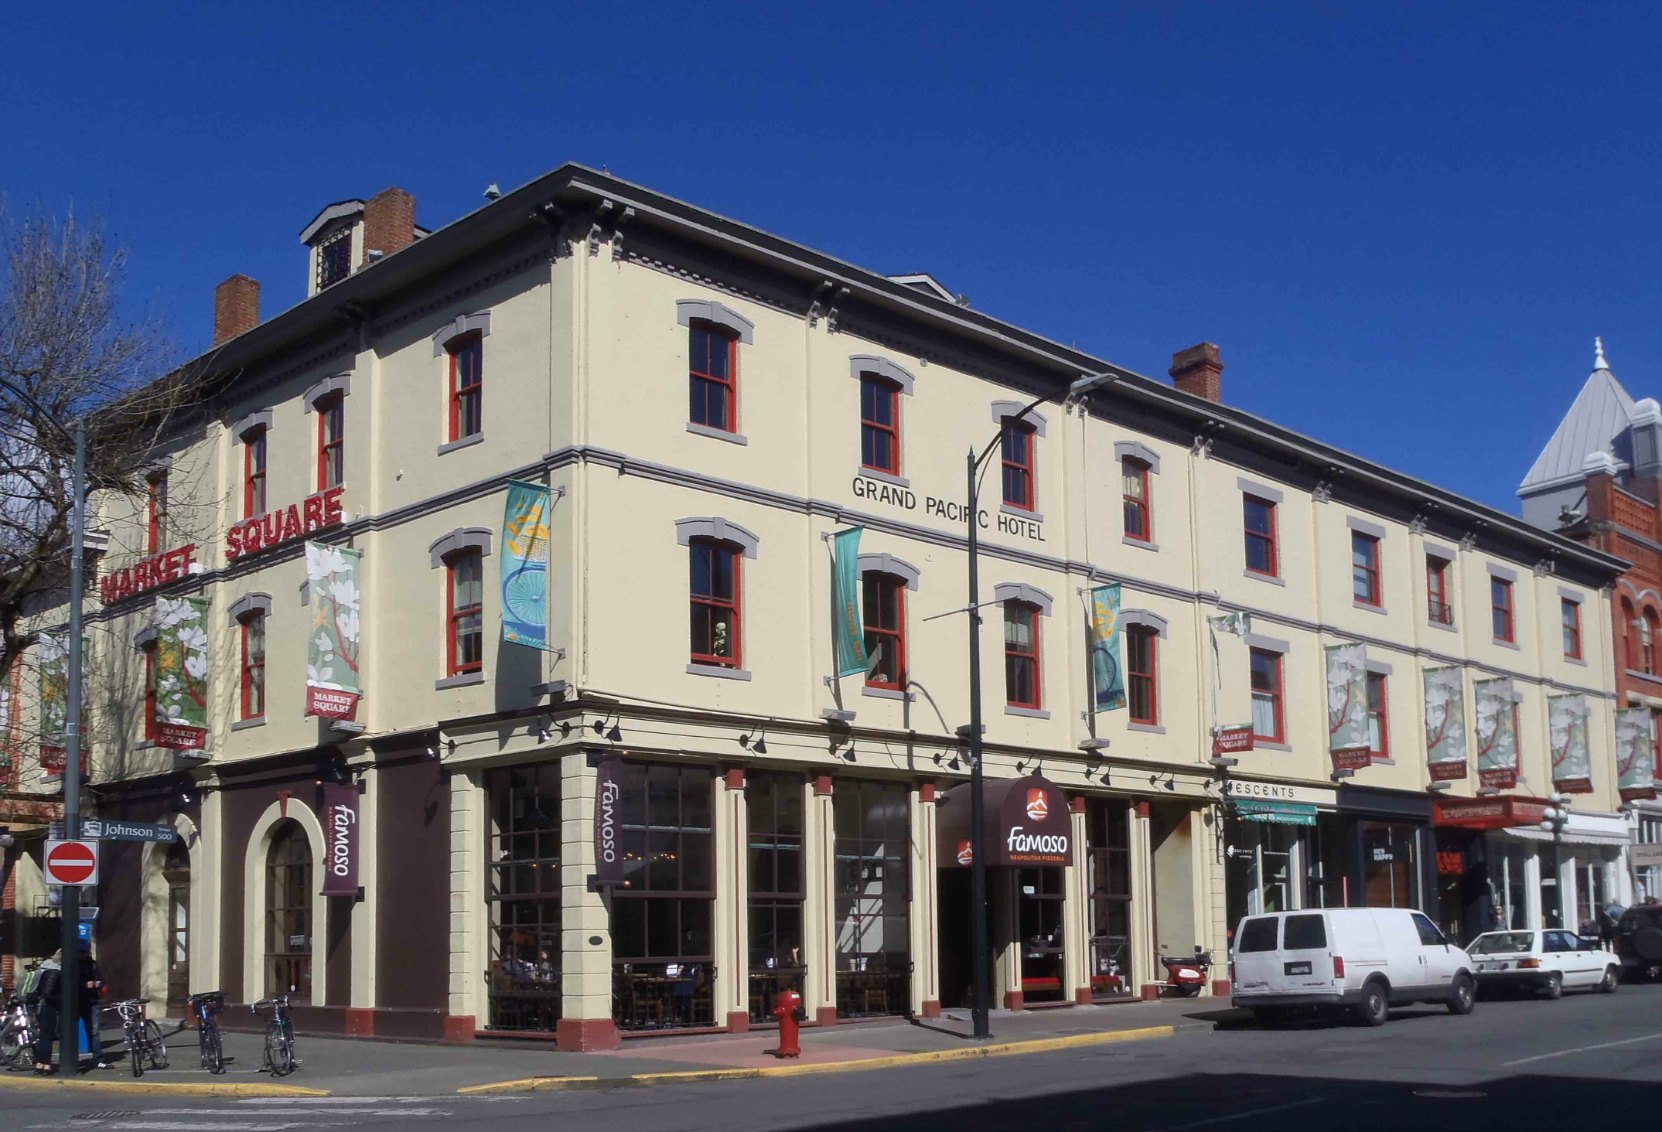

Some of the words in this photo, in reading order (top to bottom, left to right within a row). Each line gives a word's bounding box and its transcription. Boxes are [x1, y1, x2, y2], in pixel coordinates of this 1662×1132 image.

[853, 477, 916, 510] GRAND
[926, 497, 988, 529] PACIFC
[998, 514, 1045, 542] HOTEL
[100, 544, 199, 604] MARKET
[225, 488, 345, 559] SQUARE
[314, 692, 352, 706] MARKET
[313, 701, 350, 713] SQUARE
[1236, 783, 1294, 798] ESCENTS
[104, 823, 153, 837] Johnson
